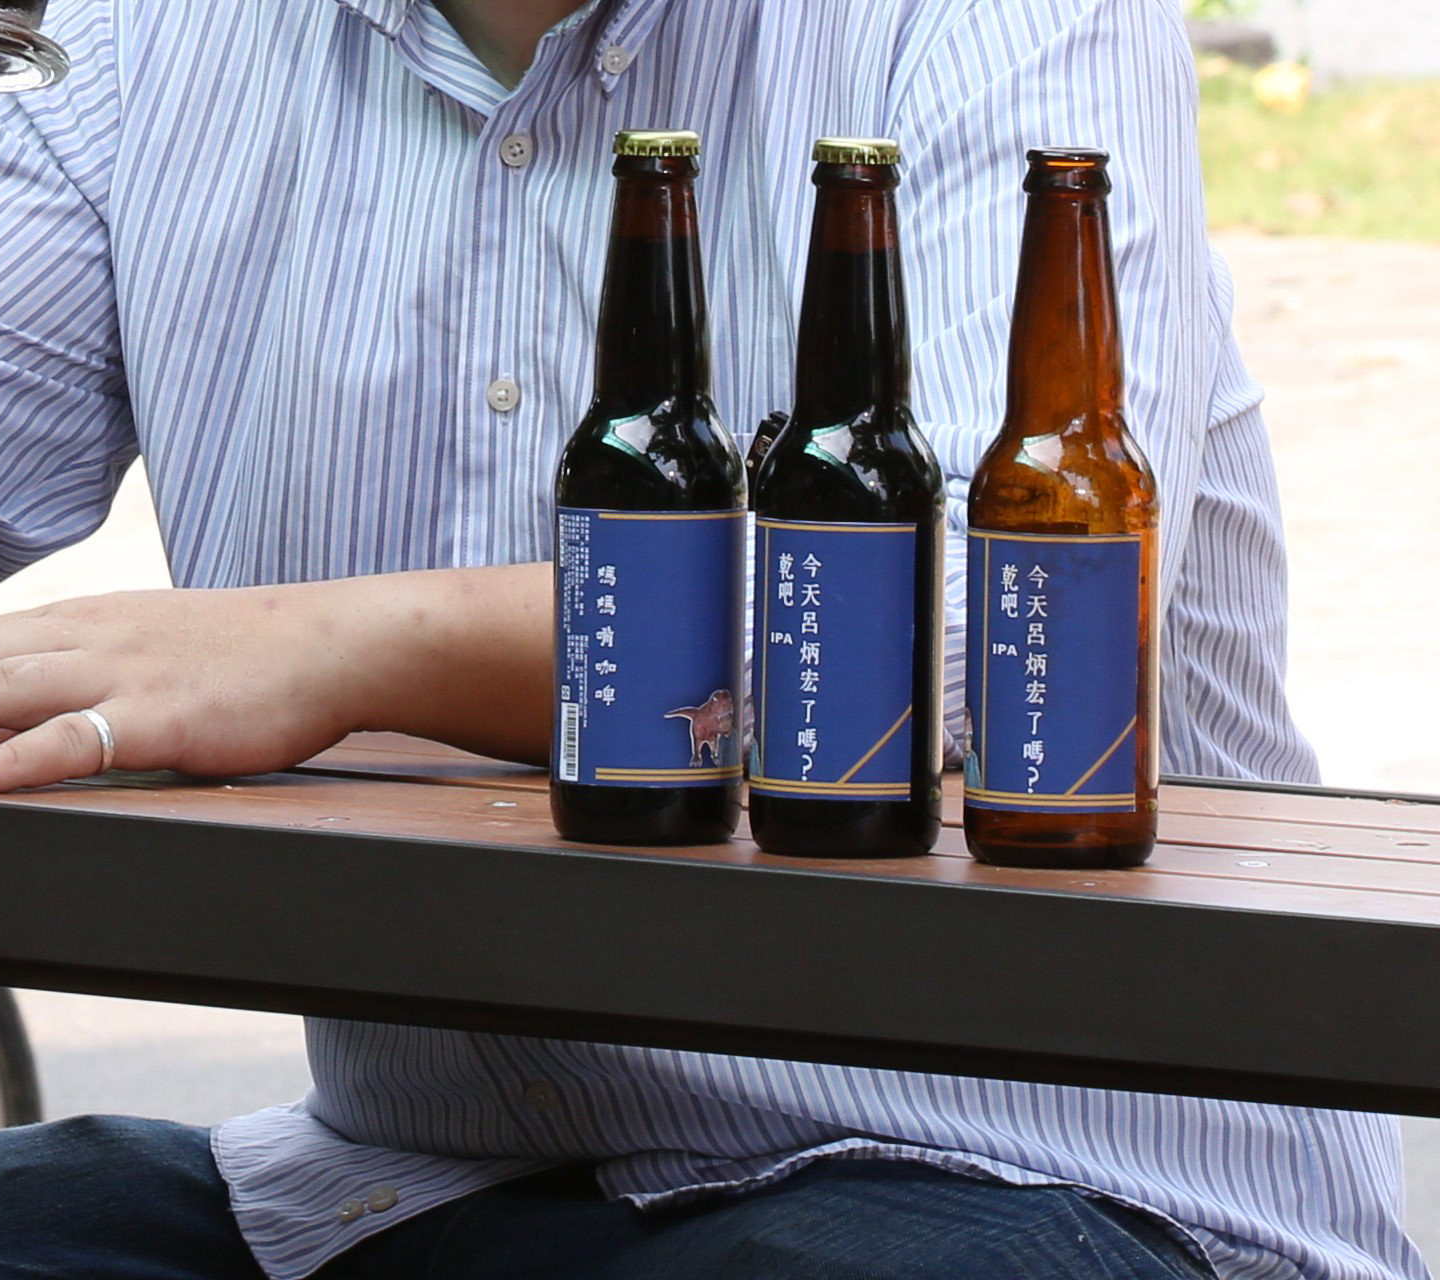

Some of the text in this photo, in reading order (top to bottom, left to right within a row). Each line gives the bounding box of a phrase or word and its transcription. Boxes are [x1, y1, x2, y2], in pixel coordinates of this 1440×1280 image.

[778, 552, 795, 608] 乾吧
[1000, 563, 1019, 619] 乾吧
[770, 631, 793, 645] IPA
[992, 642, 1018, 657] IPA
